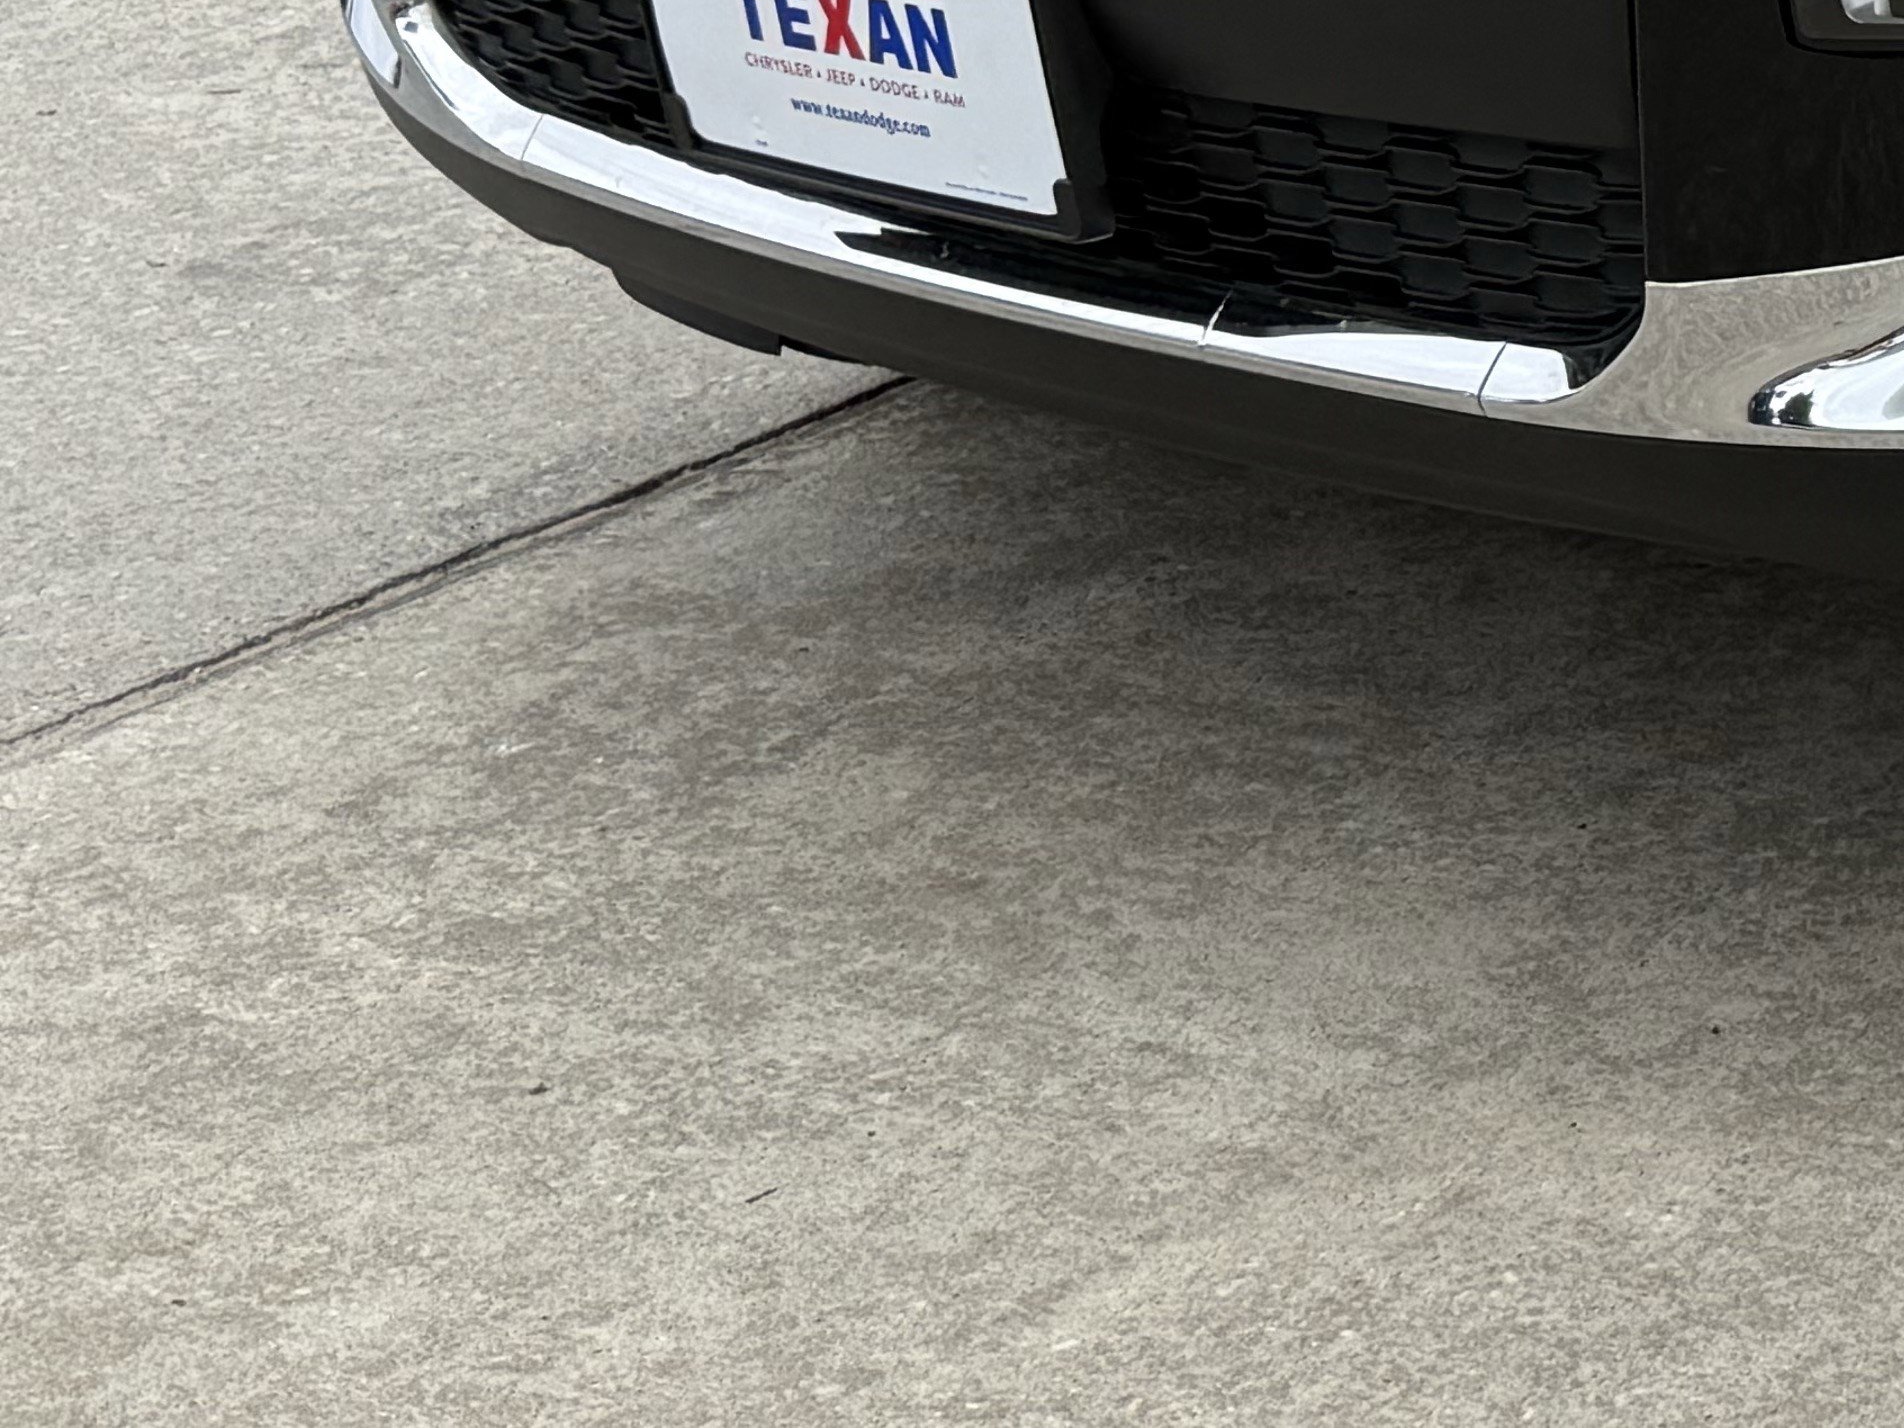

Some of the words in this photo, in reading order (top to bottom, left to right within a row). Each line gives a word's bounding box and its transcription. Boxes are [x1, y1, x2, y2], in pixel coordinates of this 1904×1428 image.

[744, 51, 813, 78] CHRYSLER
[826, 68, 856, 87] JEEP
[869, 76, 921, 100] DODGE
[933, 88, 966, 108] RAM
